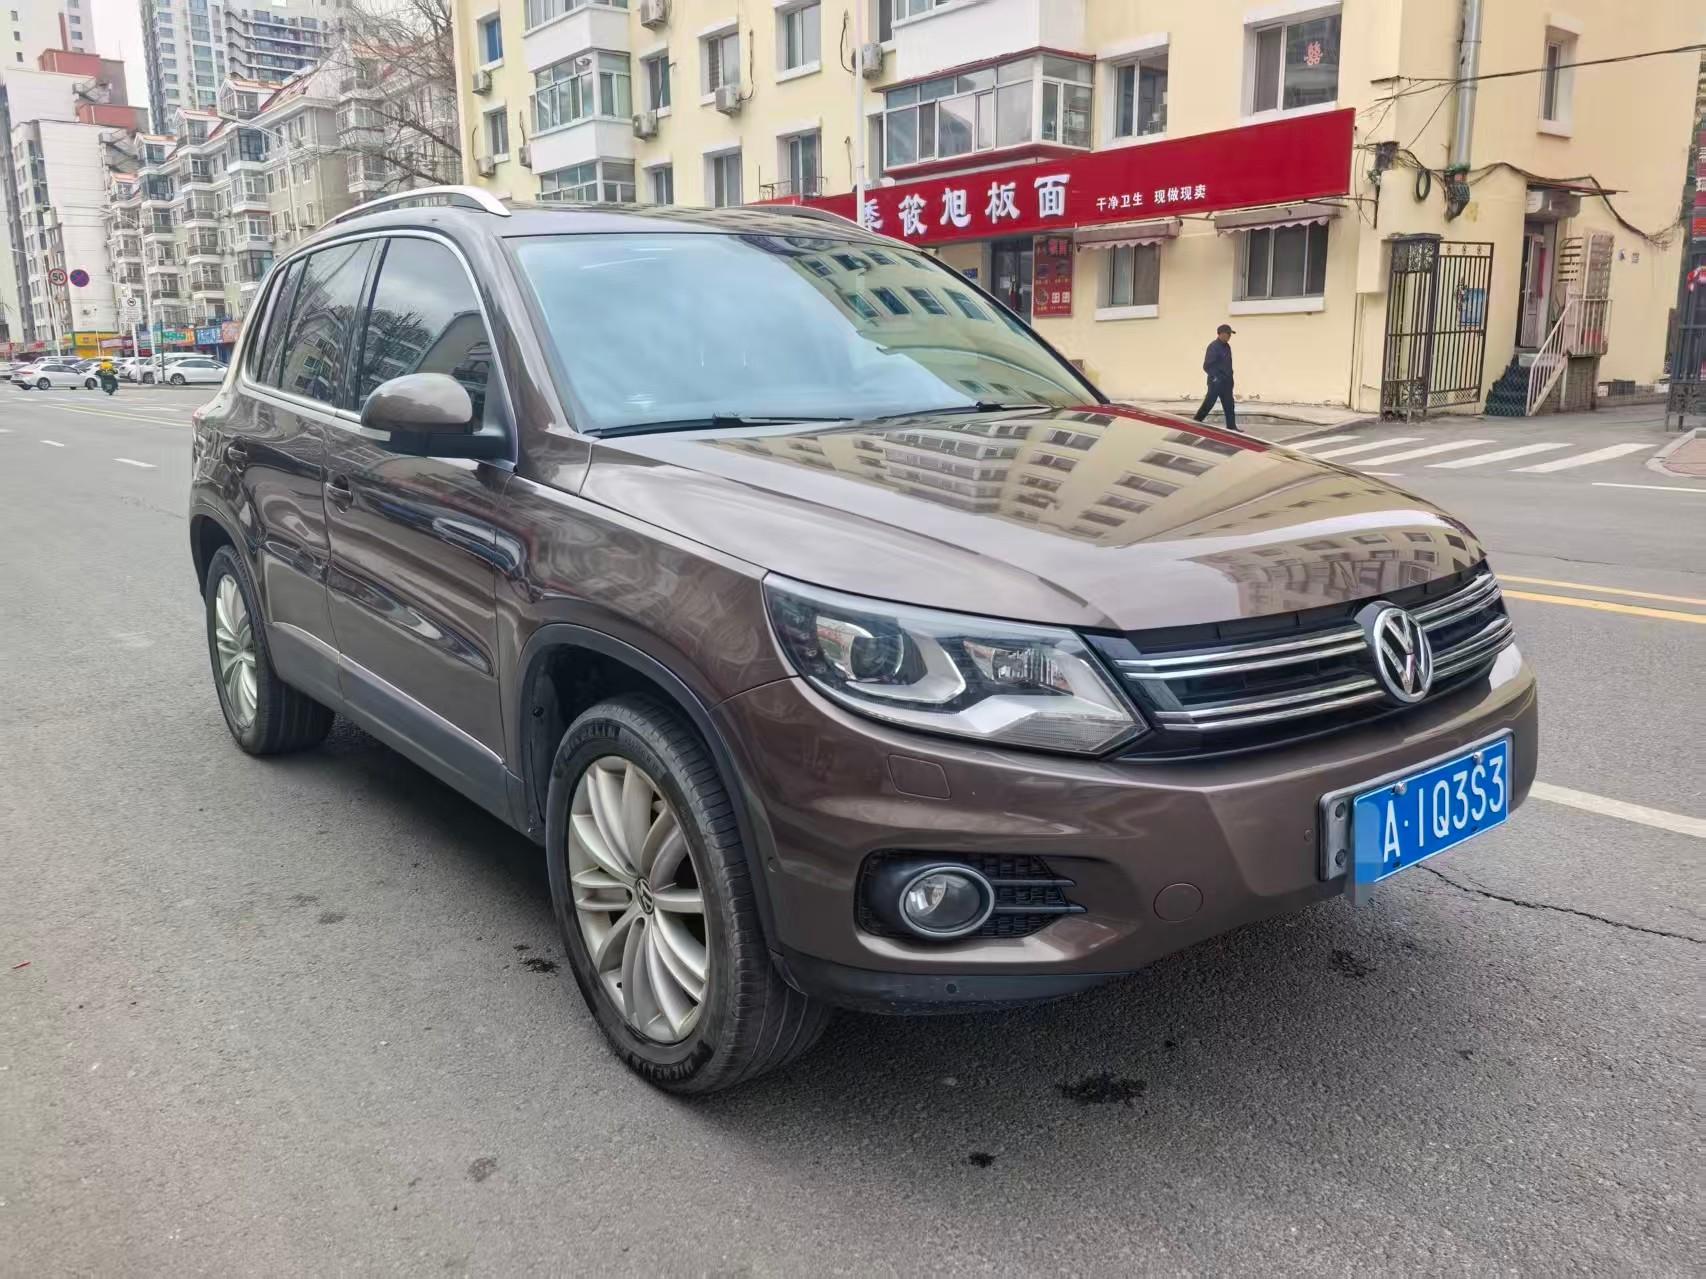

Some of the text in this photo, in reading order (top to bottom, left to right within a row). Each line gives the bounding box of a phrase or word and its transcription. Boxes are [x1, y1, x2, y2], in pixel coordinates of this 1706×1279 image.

[1096, 184, 1206, 212] 干净卫生 现做现卖
[52, 272, 64, 281] 50
